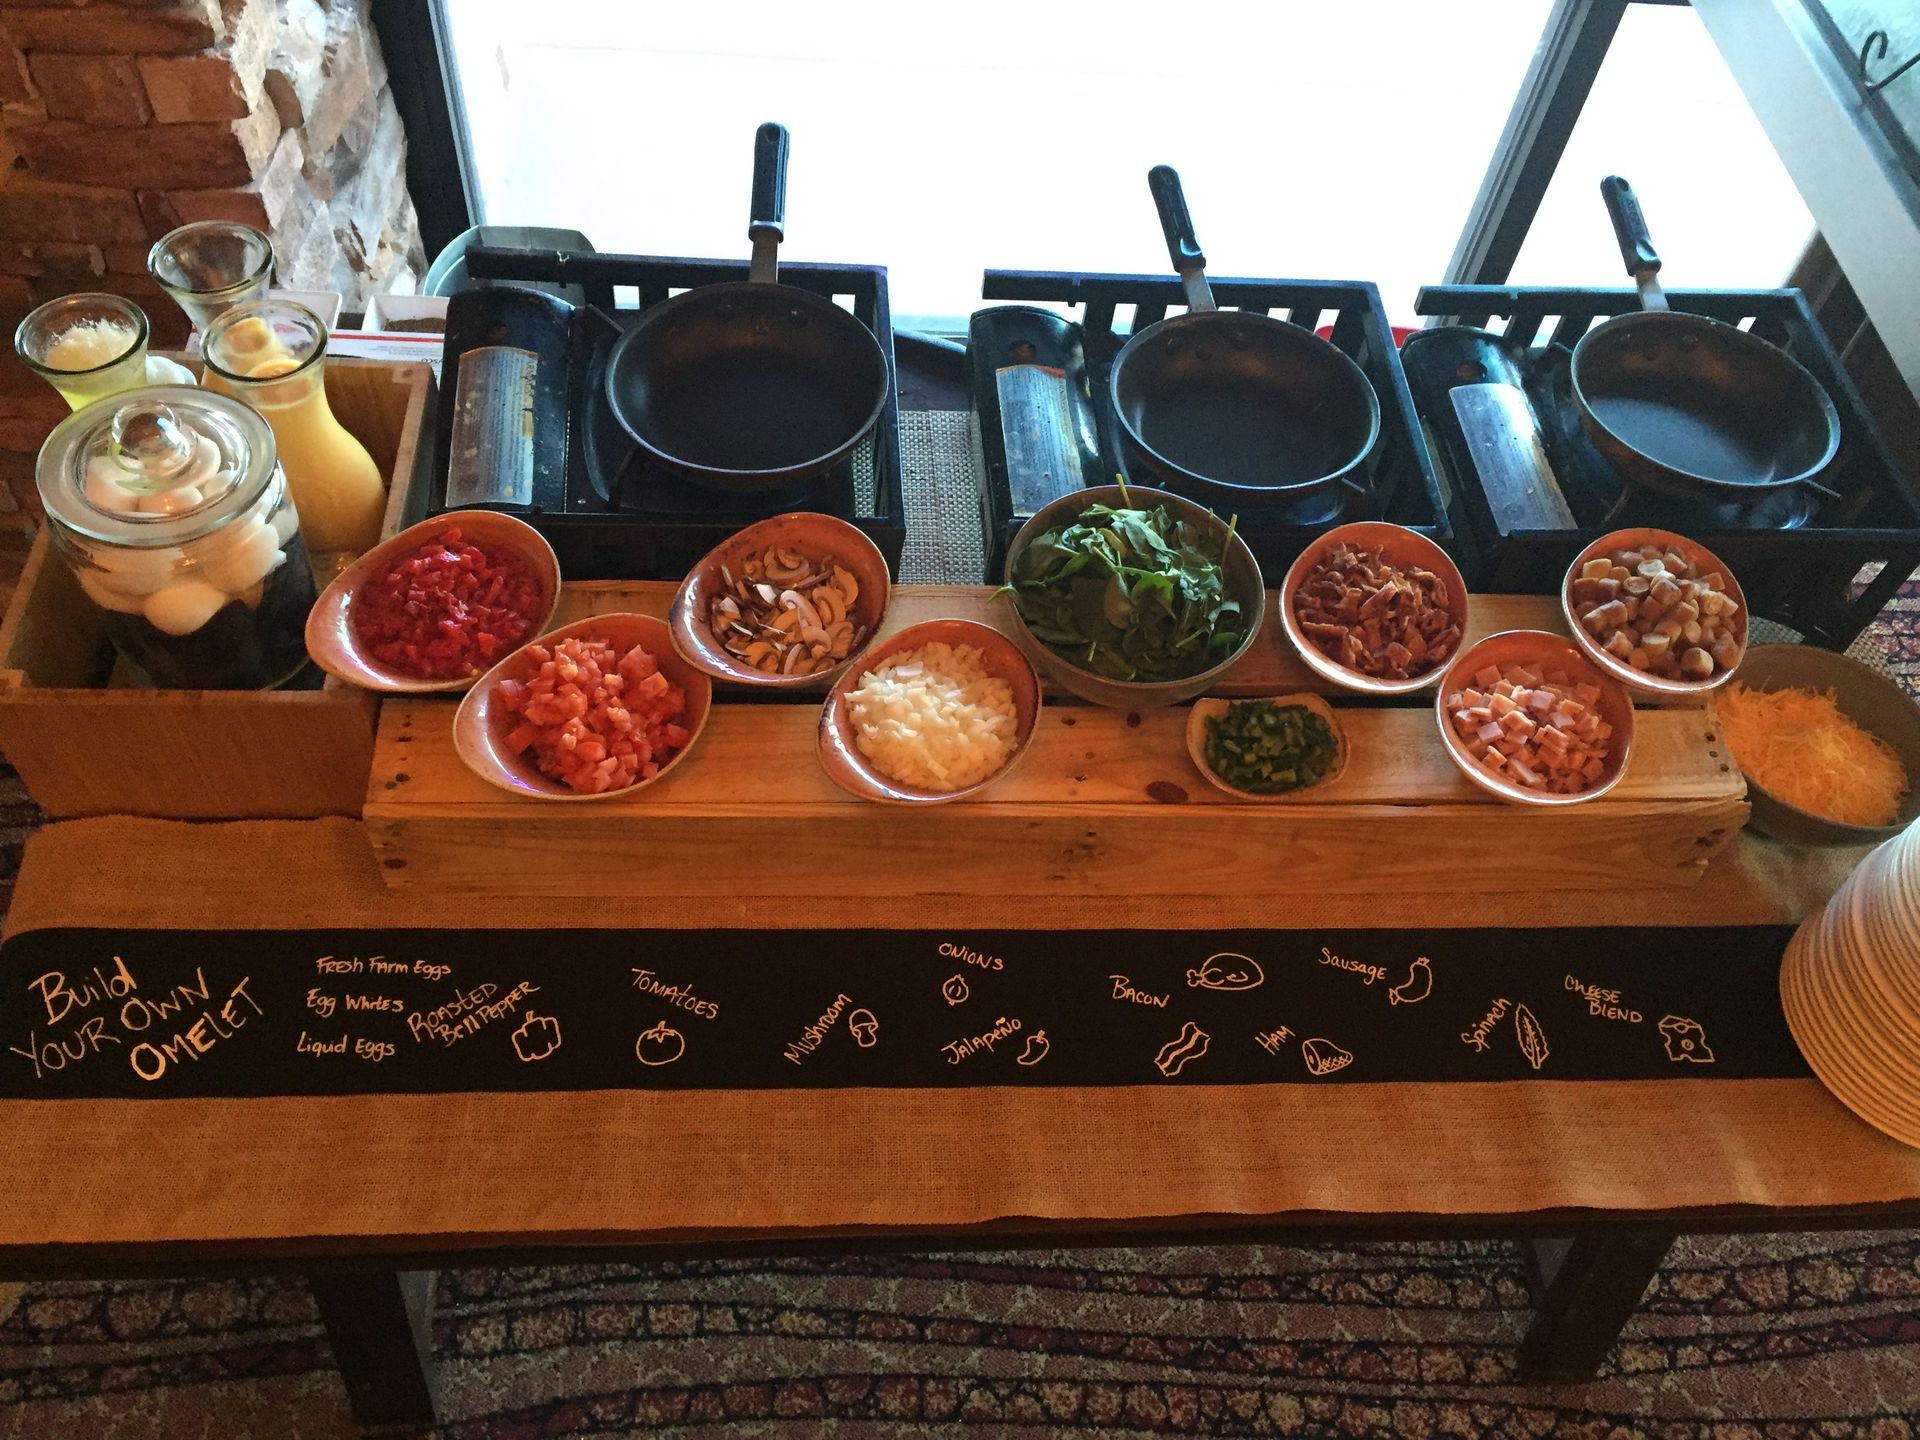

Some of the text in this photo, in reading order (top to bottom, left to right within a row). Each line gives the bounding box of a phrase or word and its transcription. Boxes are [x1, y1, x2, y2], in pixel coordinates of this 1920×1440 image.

[27, 956, 138, 1026] Build
[412, 960, 453, 982] Eggs
[9, 966, 210, 1079] YOUR OWN
[306, 987, 338, 1019] Egg
[296, 1031, 396, 1063] Liquid Eggs
[783, 993, 853, 1065] Mushroom
